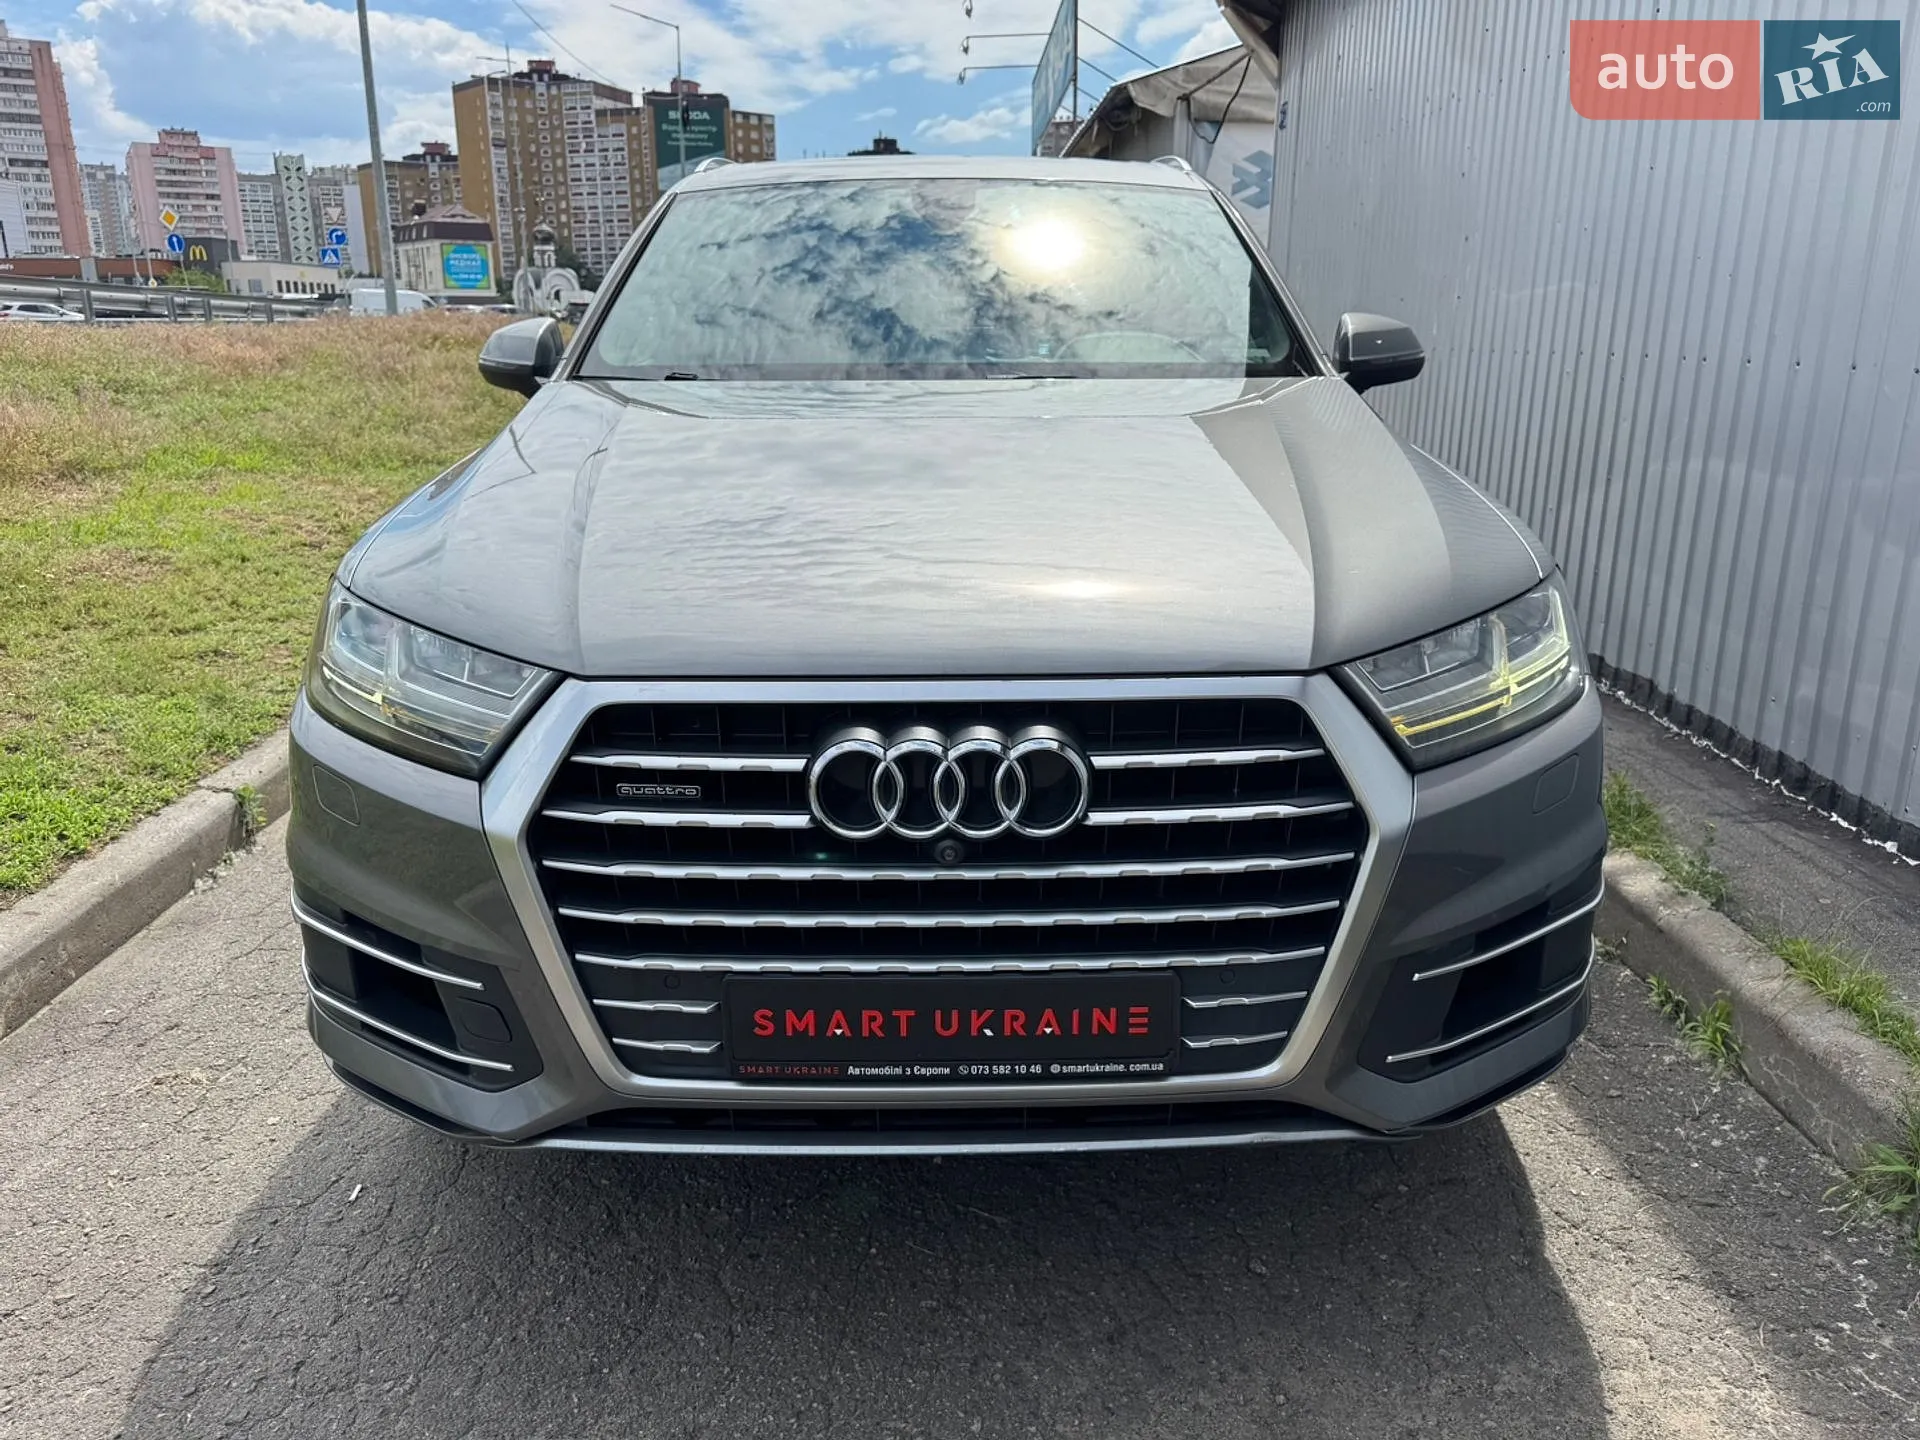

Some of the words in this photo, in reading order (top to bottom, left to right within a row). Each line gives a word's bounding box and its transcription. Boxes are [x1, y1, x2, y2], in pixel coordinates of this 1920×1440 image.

[621, 786, 697, 796] quattro
[752, 1009, 917, 1037] SMART
[934, 1006, 1150, 1037] UKRAINE
[738, 1065, 779, 1075] SMART
[784, 1066, 841, 1076] UKRAINE
[847, 1065, 903, 1076] Автомобілі
[905, 1067, 911, 1076] з
[913, 1065, 951, 1077] Європи
[970, 1064, 990, 1075] 073
[992, 1064, 1012, 1075] 582
[1014, 1064, 1027, 1074] 10
